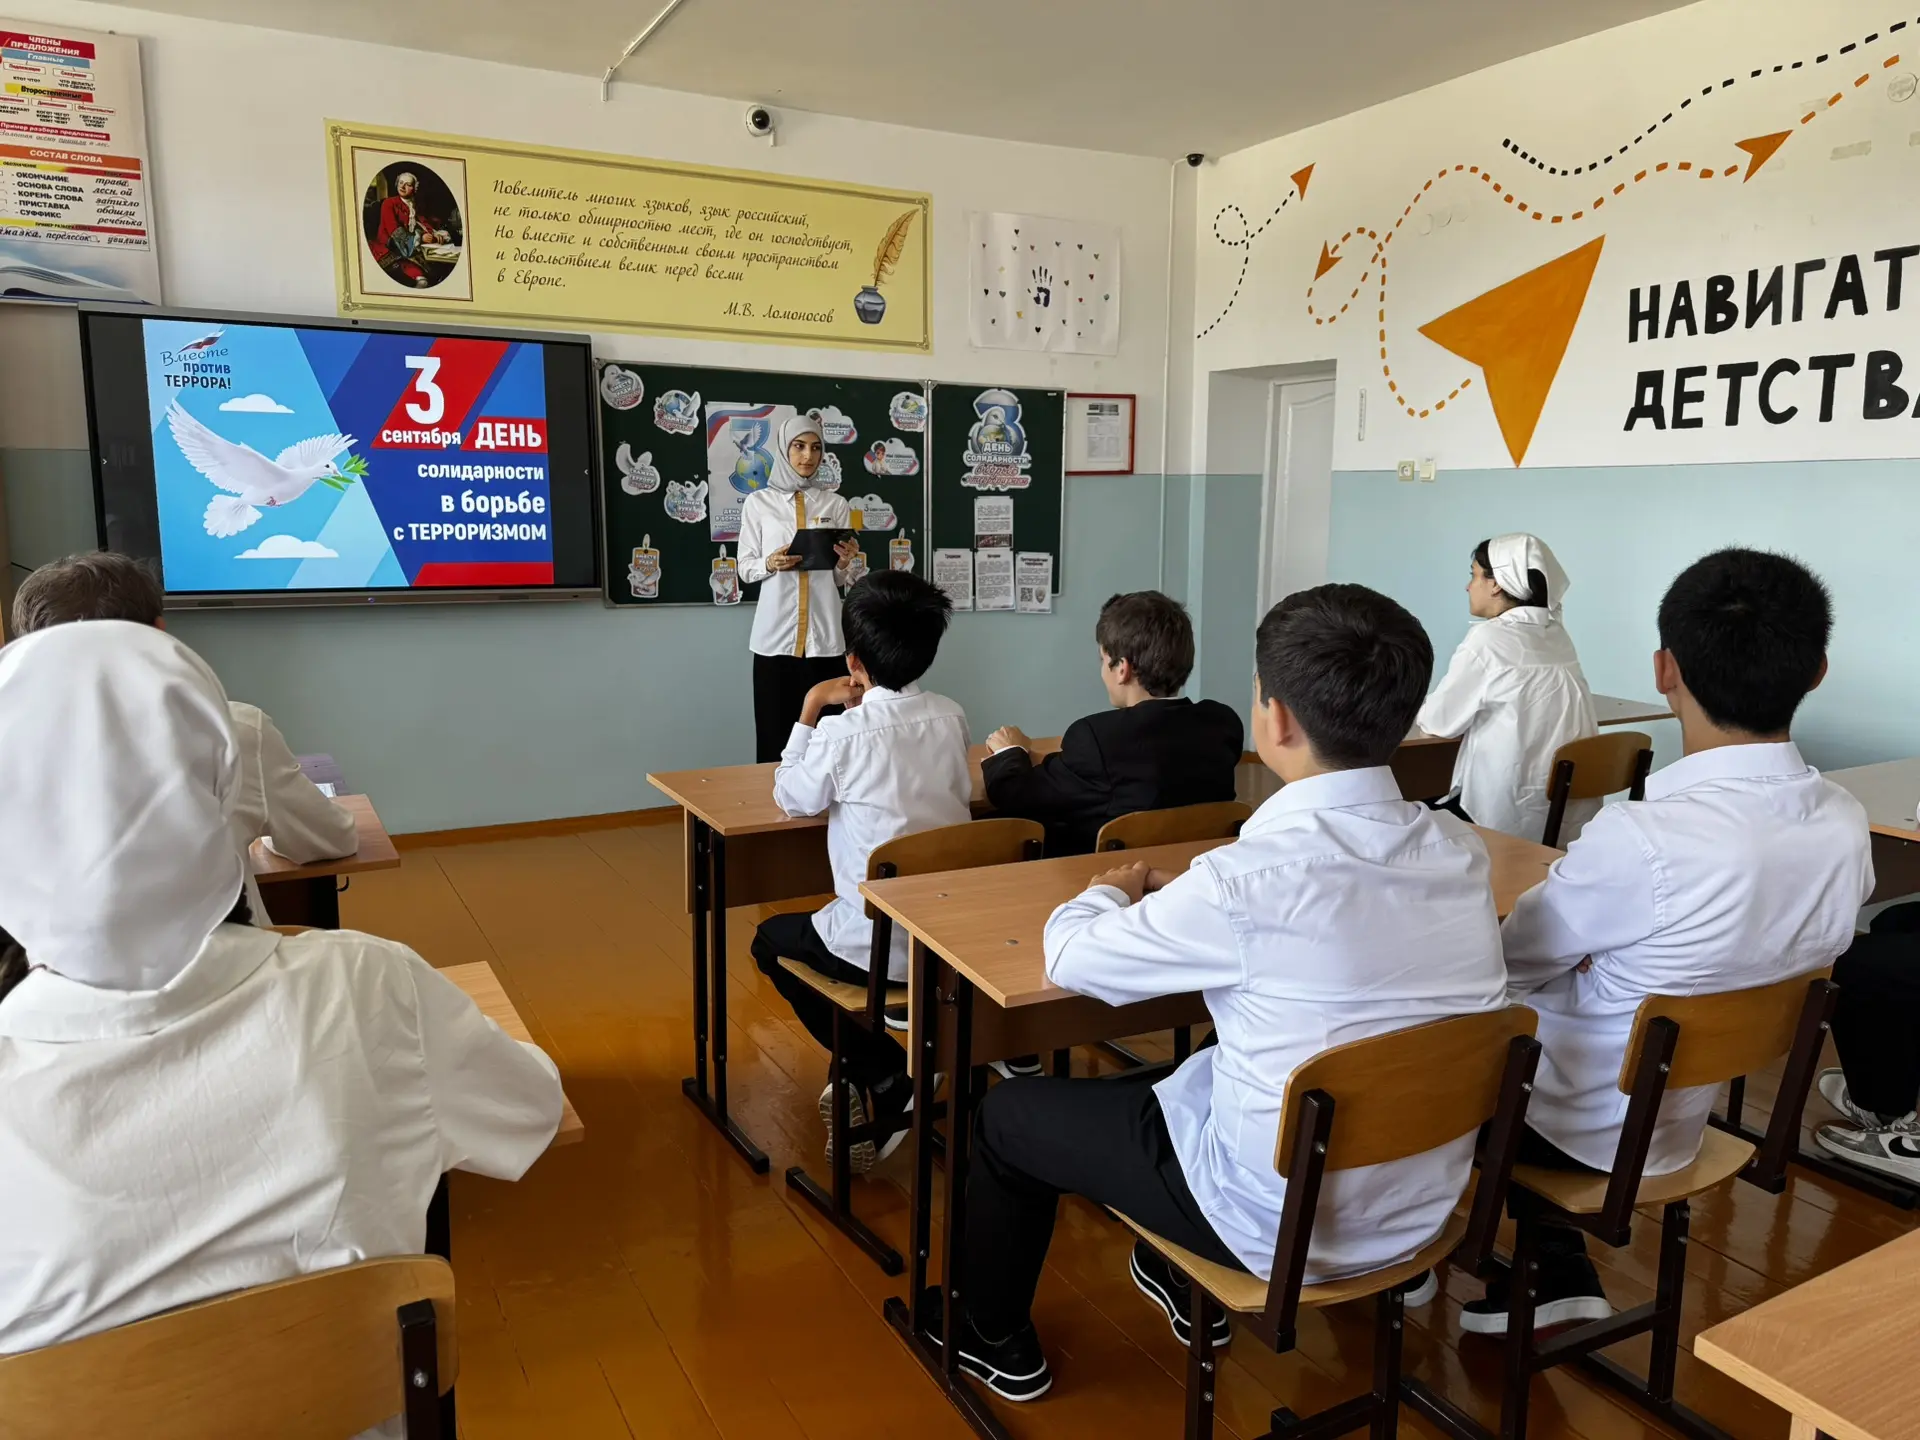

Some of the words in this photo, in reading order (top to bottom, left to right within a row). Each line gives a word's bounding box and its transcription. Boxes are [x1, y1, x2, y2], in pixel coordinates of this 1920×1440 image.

[11, 41, 80, 56] ПРЕДЛОЖЕНИЯ
[28, 36, 61, 46] ЧЛЕНЫ
[28, 53, 64, 64] Главные
[21, 85, 82, 99] Второстепенные
[1, 122, 28, 131] Пример
[30, 125, 59, 135] разбора
[29, 149, 68, 160] СОСТАВ
[70, 152, 103, 163] СЛОВА
[16, 171, 69, 182] ОКОНЧАНИЕ
[17, 181, 53, 190] ОСНОВА
[54, 184, 84, 193] СЛОВА
[18, 190, 52, 199] КОРЕНЬ
[54, 193, 83, 202] СЛОВА
[19, 199, 70, 210] ПРИСТАВКА
[493, 179, 579, 202] Повелитель
[585, 191, 637, 208] многих
[643, 198, 692, 215] языков,
[699, 204, 731, 221] язык
[735, 209, 810, 229] российский,
[20, 209, 61, 218] СУФФИКС
[493, 205, 511, 217] не
[518, 206, 571, 222] только
[578, 207, 672, 233] обширностью
[678, 223, 717, 240] мест,
[725, 225, 743, 240] где
[748, 231, 764, 242] он
[771, 233, 853, 255] господствует,
[494, 224, 514, 239] Но
[522, 225, 576, 245] вместе
[582, 236, 592, 246] и
[599, 231, 689, 255] собственным
[695, 242, 736, 260] своим
[742, 251, 839, 271] пространством
[496, 250, 506, 261] и
[513, 247, 612, 270] довольствием
[618, 255, 659, 275] велик
[664, 263, 699, 282] перед
[705, 264, 745, 281] всеми
[497, 267, 505, 283] в
[513, 269, 566, 291] Европе.
[1628, 244, 1920, 343] НАВИГАТ
[723, 302, 755, 318] М.В.
[762, 304, 835, 324] Ломоносов
[160, 348, 229, 367] Вместе
[183, 362, 231, 375] против
[164, 374, 231, 390] ТЕРРОРА!
[404, 355, 445, 425] 3
[1623, 349, 1920, 431] ДЕТСТВ
[381, 427, 462, 448] сентября
[474, 422, 542, 449] ДЕНЬ
[983, 442, 1011, 453] ДЕНЬ
[966, 454, 1028, 464] СОЛИДАРНОСТИ
[417, 463, 544, 482] солидарности
[441, 494, 455, 512] в
[460, 489, 546, 518] борьбе
[393, 526, 404, 541] с
[408, 523, 547, 541] ТЕРРОРИЗМОМ
